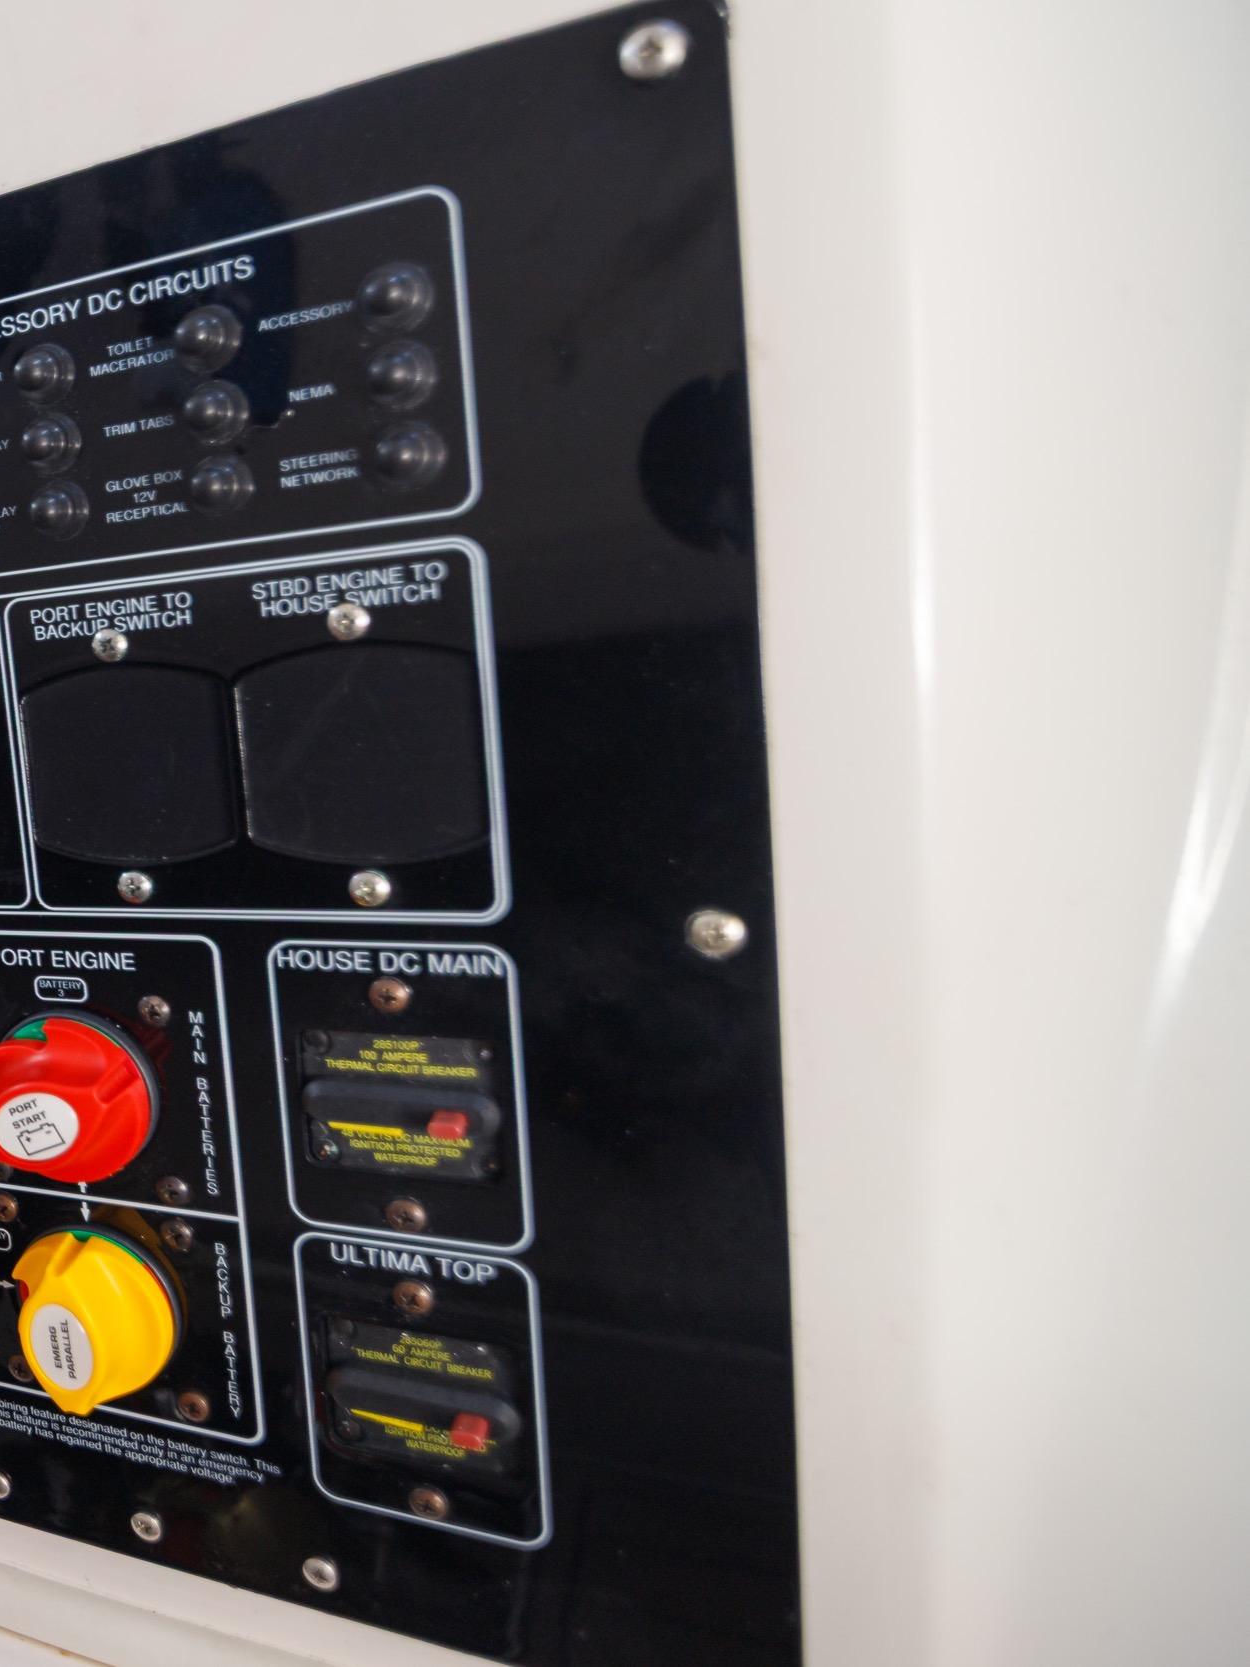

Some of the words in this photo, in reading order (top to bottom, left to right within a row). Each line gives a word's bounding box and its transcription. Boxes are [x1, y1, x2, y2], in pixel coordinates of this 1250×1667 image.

[87, 289, 123, 315] DC
[129, 255, 255, 304] CIRCUITS
[258, 300, 354, 332] ACCESSORY
[107, 336, 154, 357] TOILET
[90, 348, 176, 377] MACERATOR
[288, 384, 336, 403] NEMA
[103, 420, 136, 438] TRIM
[137, 414, 174, 432] TABS
[280, 448, 358, 472] STEERING
[105, 475, 151, 493] GLOVE
[153, 469, 183, 486] BOX
[281, 466, 359, 489] NETWORK
[133, 489, 157, 503] 12V
[106, 502, 190, 524] RECEPTICAL
[252, 578, 312, 600] STBD
[316, 566, 405, 593] ENGINE
[409, 561, 448, 582] TO
[30, 604, 82, 625] PORT
[85, 595, 158, 618] ENGINE
[162, 591, 193, 610] TO
[260, 592, 340, 618] HOUSE
[344, 582, 441, 607] SWITCH
[34, 619, 111, 641] BACKUP
[114, 609, 193, 633] SWITCH
[50, 950, 137, 971] ENGINE
[276, 948, 373, 973] HOUSE
[379, 952, 422, 974] DC
[428, 953, 505, 976] MAIN
[38, 979, 82, 991] BATTERY
[188, 1010, 208, 1064] MAIN
[324, 1058, 375, 1072] THERMAL
[376, 1062, 420, 1074] CIRCUIT
[422, 1065, 478, 1078] BREAKER
[358, 1050, 378, 1060] 100
[382, 1051, 428, 1064] AMPERE
[7, 1098, 38, 1118] PORT
[11, 1110, 47, 1130] START
[196, 1077, 221, 1197] BATTERIES
[350, 1139, 394, 1152] IGNITION
[396, 1143, 462, 1159] PROTECTED
[373, 1152, 438, 1167] WATERPROOF
[329, 1241, 431, 1276] ULTIMA
[435, 1256, 498, 1284] TOP
[214, 1242, 232, 1318] BACKUP
[48, 1325, 63, 1370] EMERG
[61, 1319, 78, 1380] PARALLEL
[392, 1343, 407, 1355] 60
[410, 1347, 450, 1361] AMPERE
[222, 1331, 242, 1419] BATTERY
[356, 1348, 400, 1364] THERMAL
[403, 1356, 442, 1371] CIRCUIT
[446, 1363, 495, 1380] BREAKER
